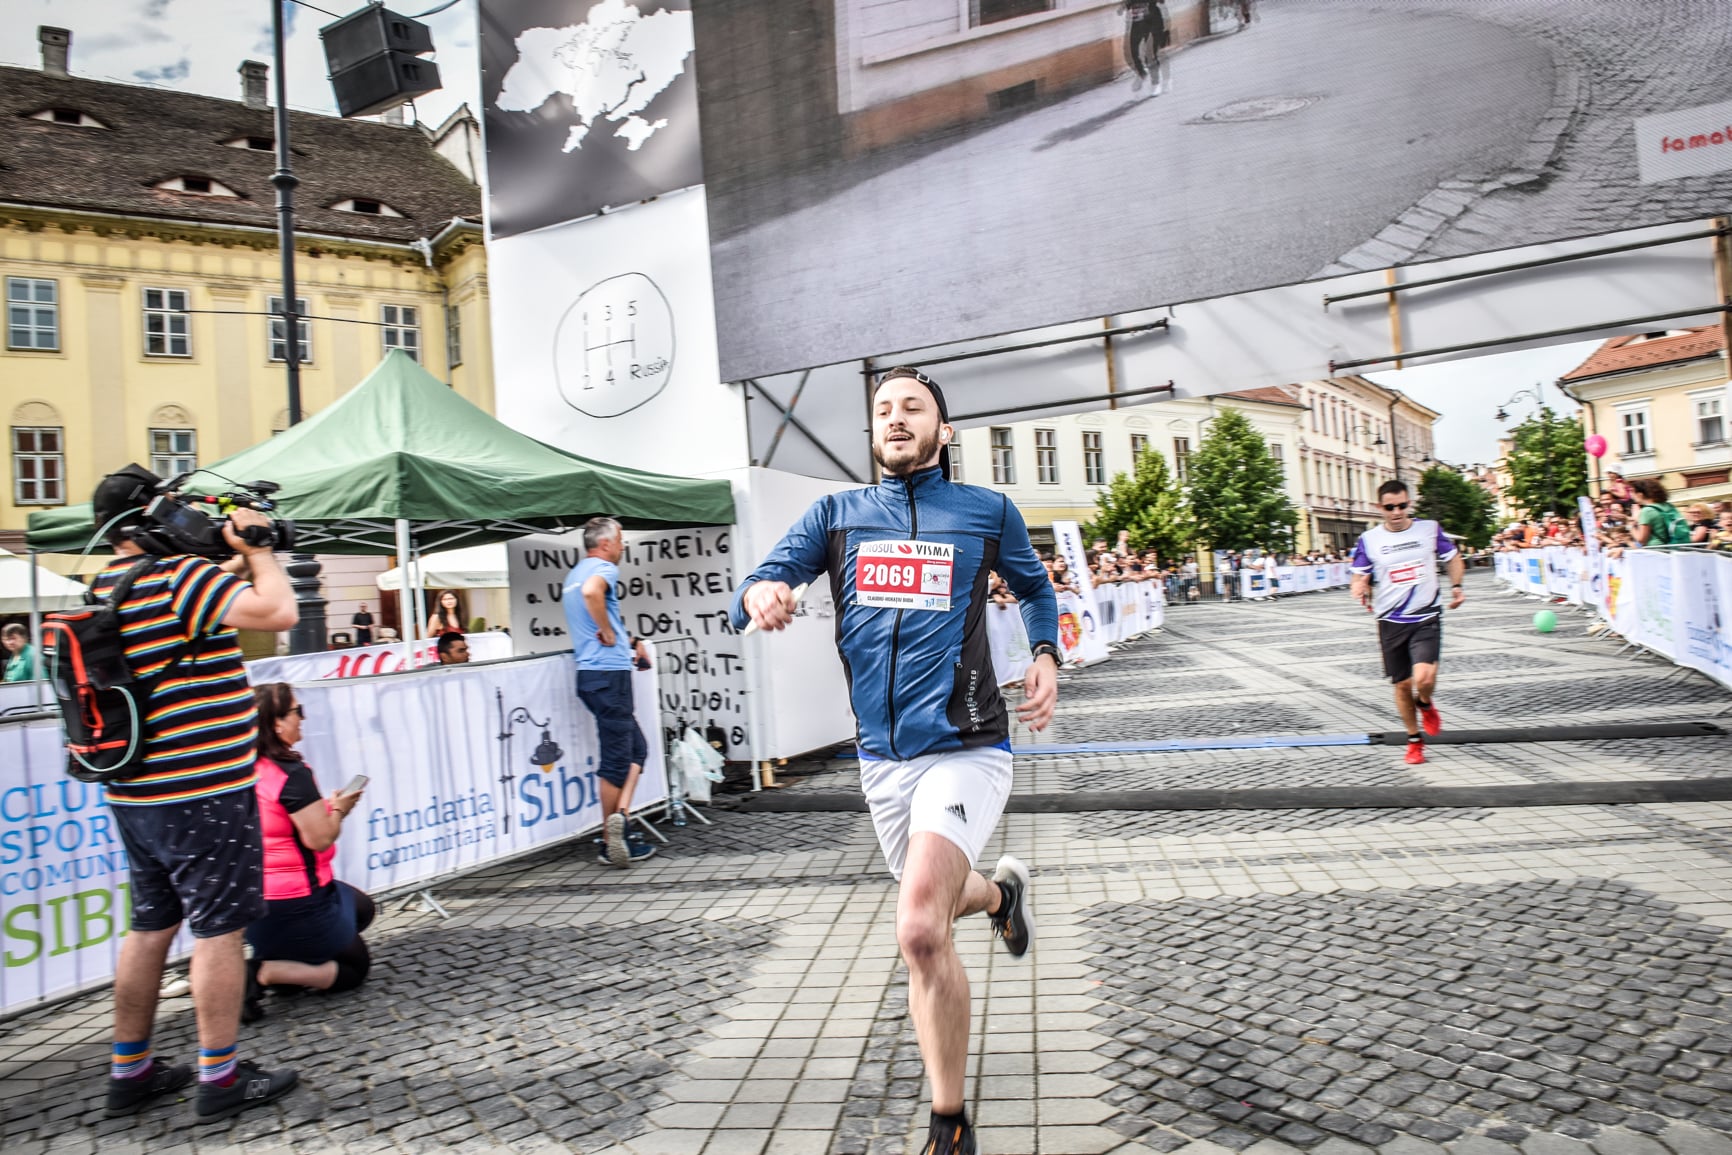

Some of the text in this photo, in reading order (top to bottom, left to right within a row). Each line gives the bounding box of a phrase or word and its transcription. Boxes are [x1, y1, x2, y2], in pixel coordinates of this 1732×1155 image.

[604, 305, 614, 321] 3
[627, 300, 639, 316] 5
[916, 544, 951, 558] VISMA
[863, 563, 915, 588] 2069
